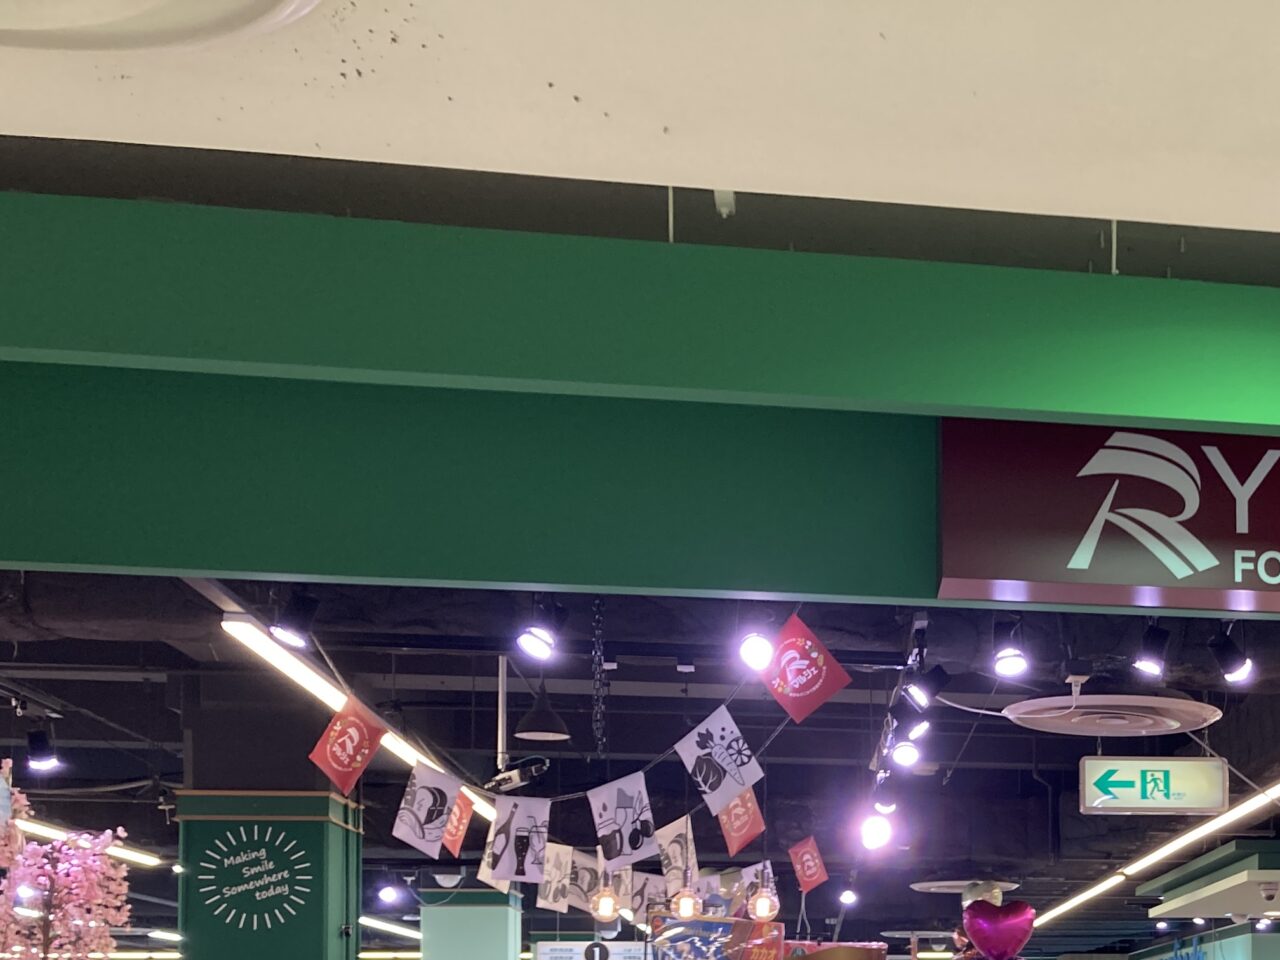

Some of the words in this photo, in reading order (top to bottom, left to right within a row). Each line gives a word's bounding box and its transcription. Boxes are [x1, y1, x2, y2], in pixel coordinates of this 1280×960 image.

[223, 847, 267, 868] Making
[242, 860, 275, 878] Smile
[222, 870, 290, 898] Somewhere
[255, 884, 289, 900] today
[751, 947, 777, 960] カカオ
